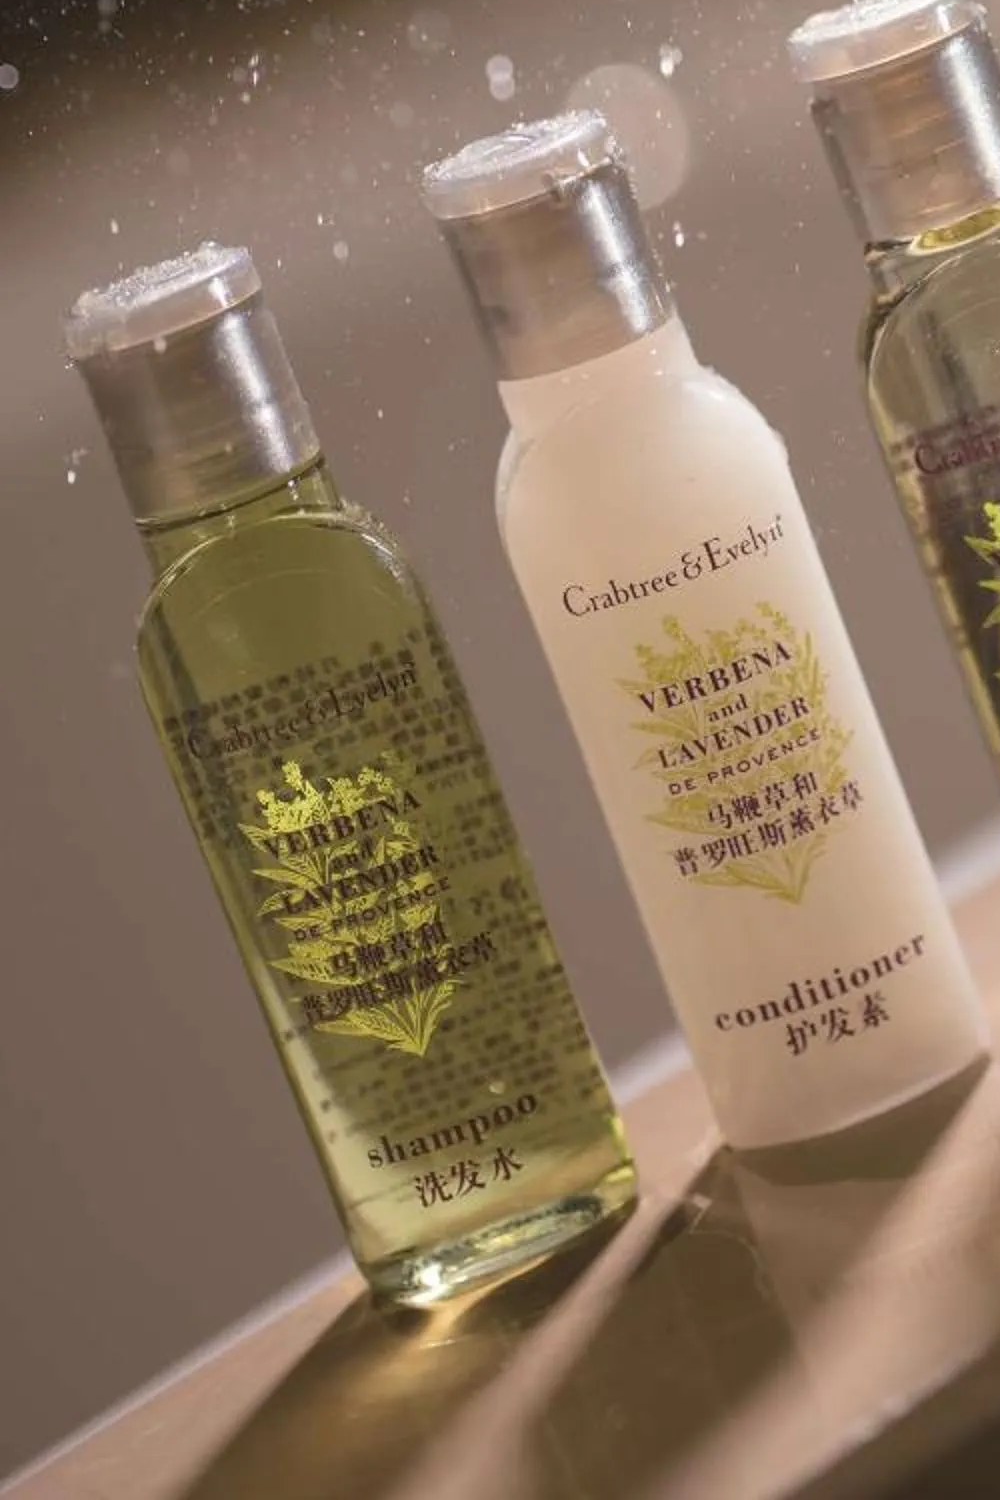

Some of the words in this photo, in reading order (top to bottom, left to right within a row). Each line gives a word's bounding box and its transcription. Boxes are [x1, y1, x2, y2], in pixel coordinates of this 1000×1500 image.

[638, 640, 792, 714] VERBENA
[706, 695, 748, 722] and
[658, 696, 811, 771] LAVENDER
[668, 776, 694, 796] DE
[707, 728, 822, 785] PROVENCE
[259, 790, 422, 861] VERBENA
[673, 780, 864, 878] 普罗旺斯薰衣草
[708, 772, 819, 830] 马鞭草和
[284, 844, 438, 915] LAVENDER
[330, 845, 374, 872] and
[331, 876, 451, 934] PROVENCE
[715, 934, 925, 1032] conditioner
[784, 992, 890, 1056] 护发素
[368, 1091, 538, 1169] shampoo
[414, 1147, 525, 1208] 洗发水
